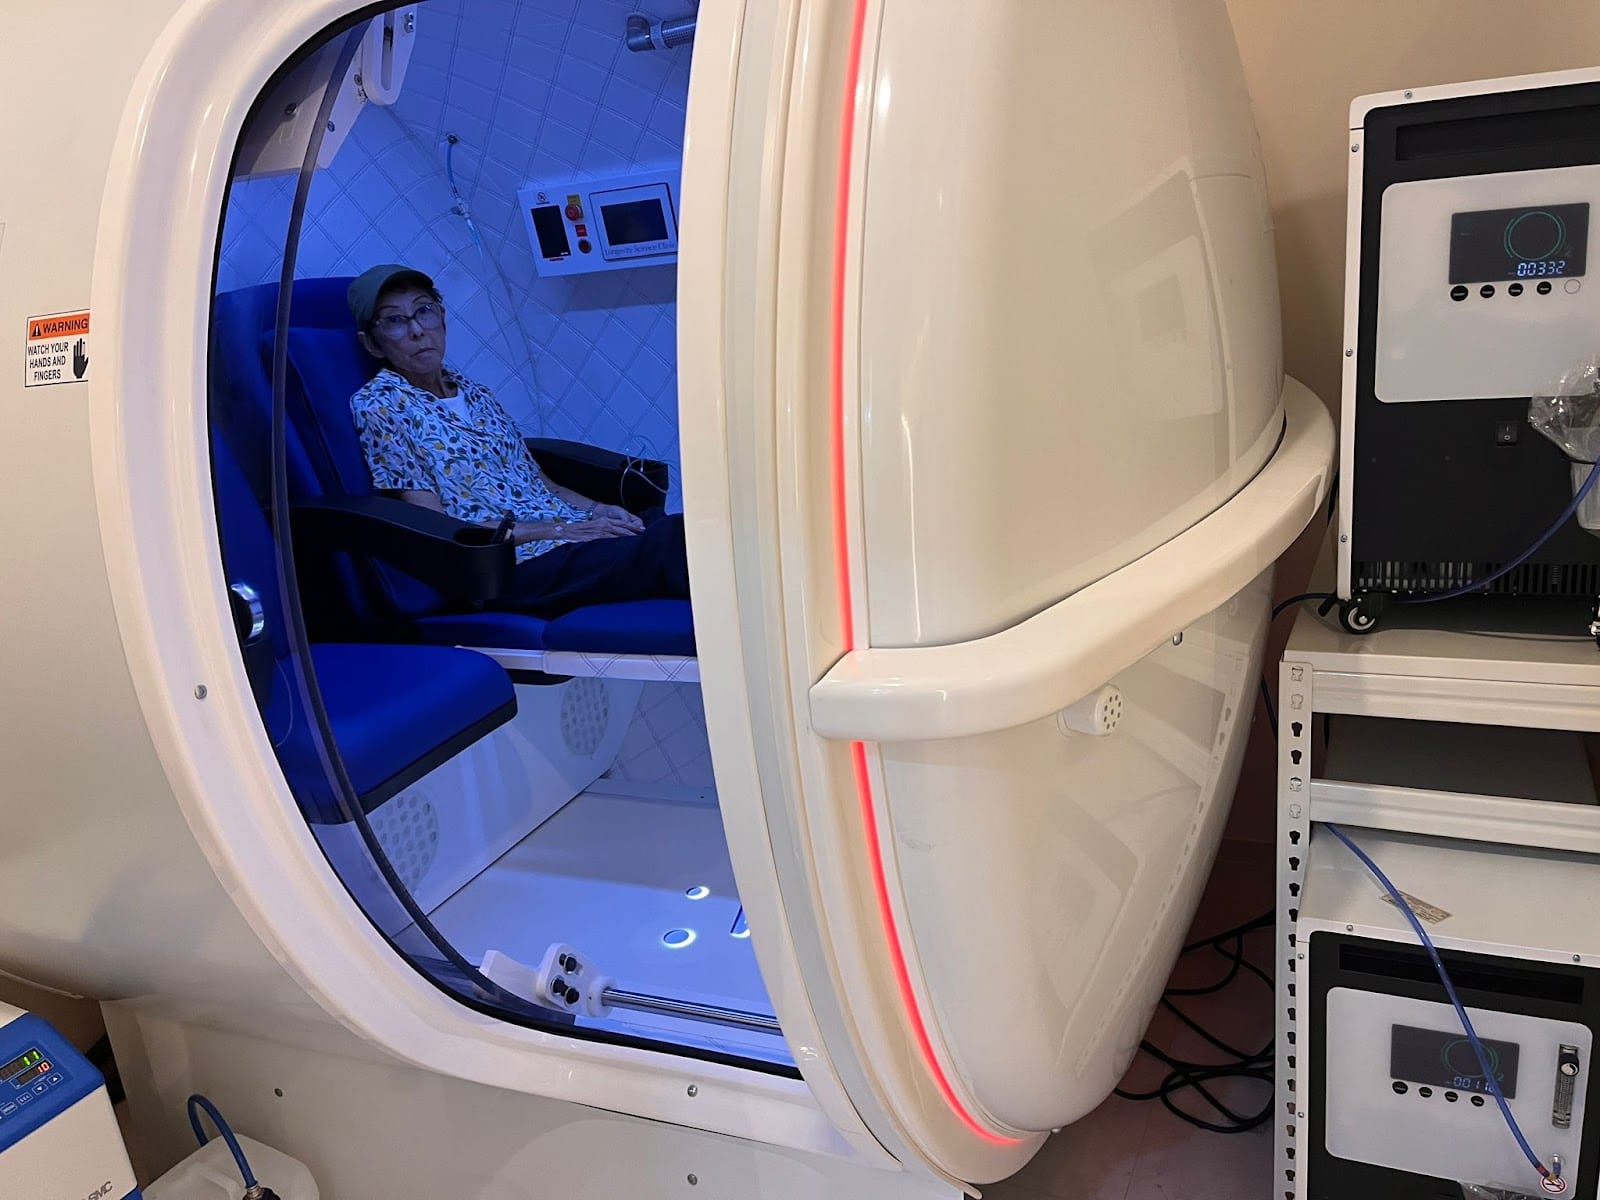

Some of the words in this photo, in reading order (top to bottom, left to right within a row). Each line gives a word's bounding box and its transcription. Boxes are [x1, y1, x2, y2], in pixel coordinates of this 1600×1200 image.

[1517, 260, 1566, 277] 00332
[42, 318, 88, 333] WARNING
[28, 344, 50, 356] WATCH
[50, 341, 69, 353] YOUR
[29, 357, 52, 369] HANDS
[52, 355, 66, 366] AND
[33, 369, 61, 382] FINGERS
[37, 1061, 50, 1073] 10
